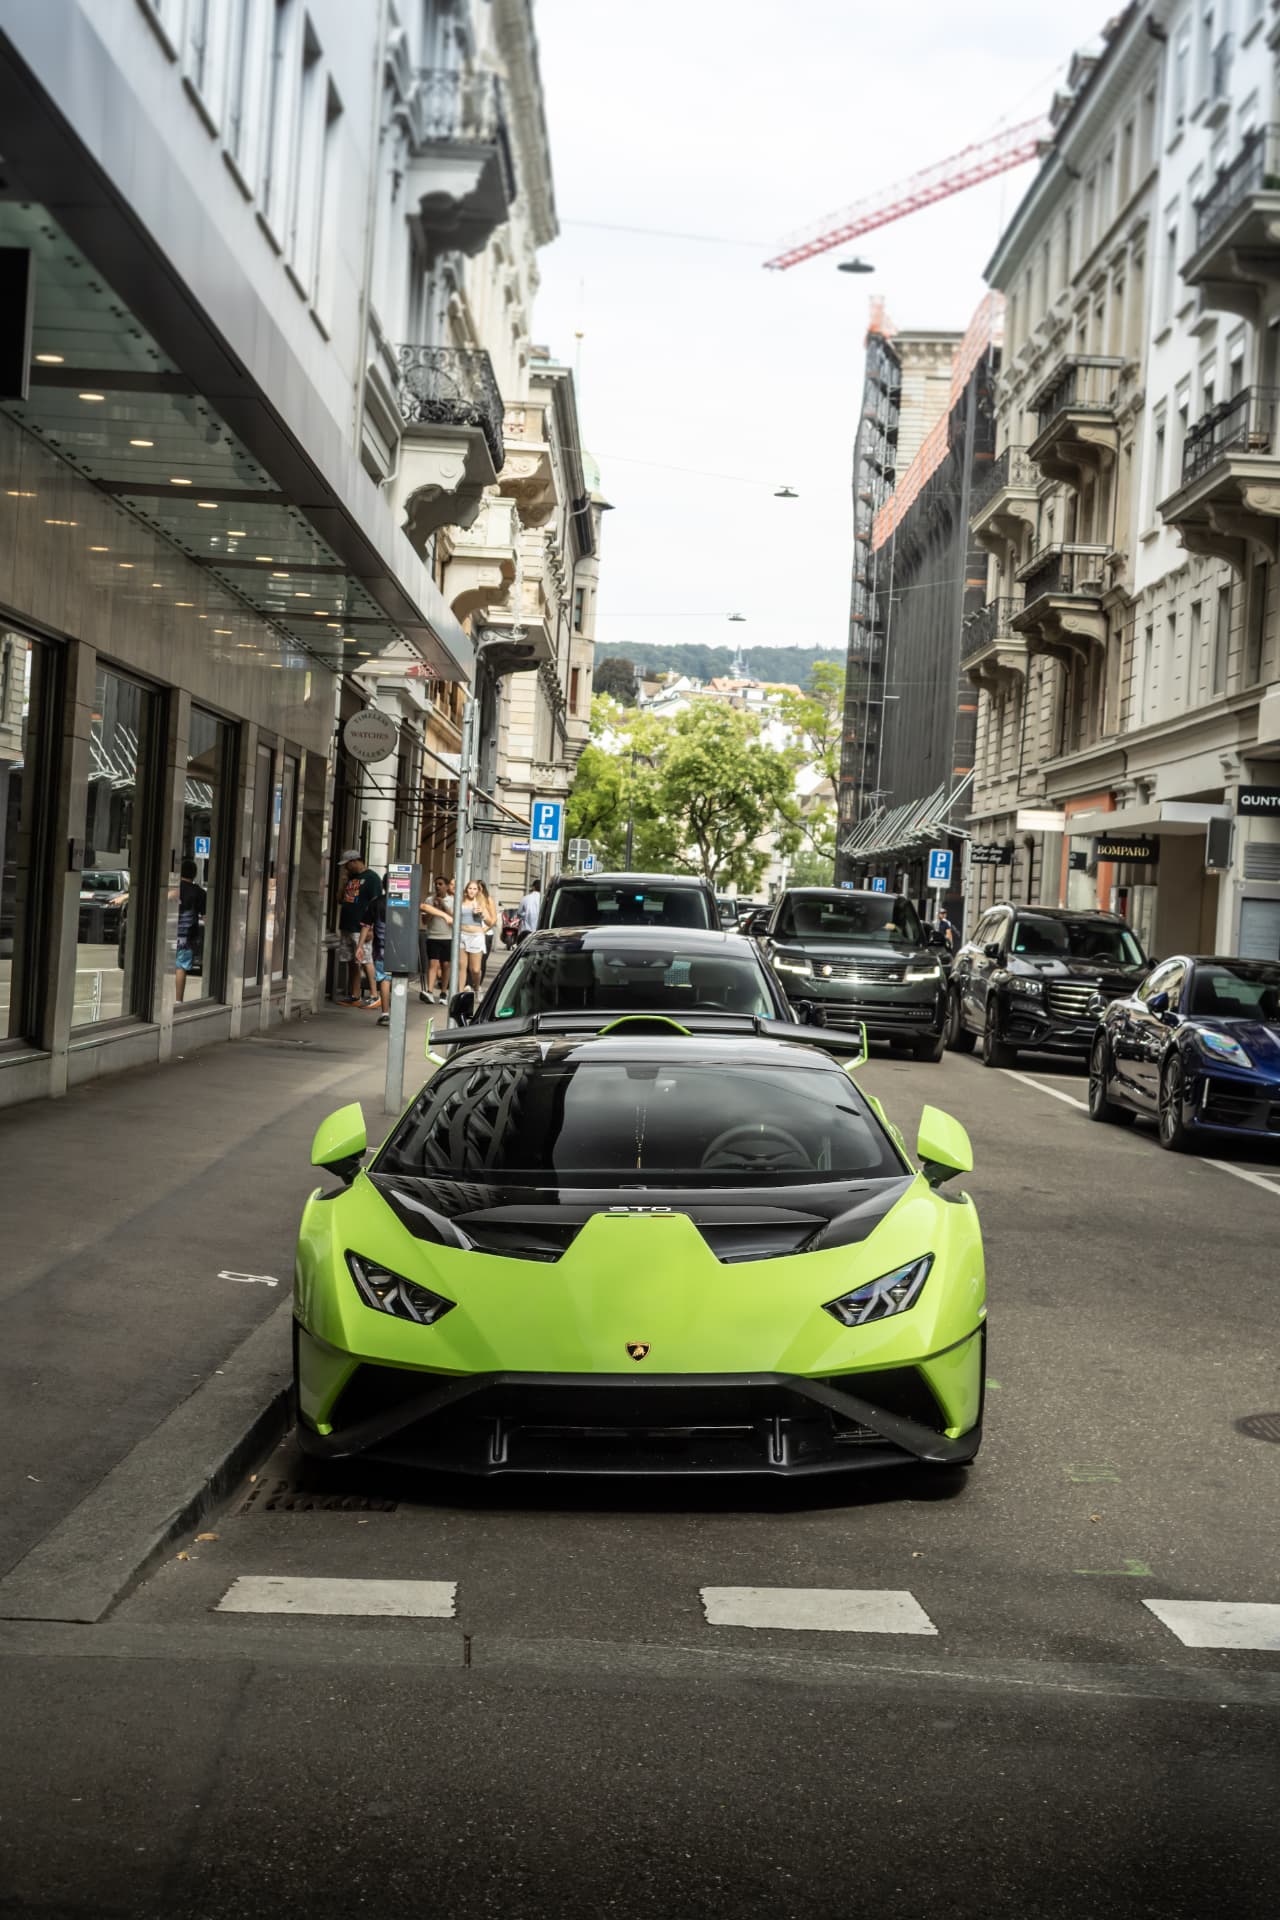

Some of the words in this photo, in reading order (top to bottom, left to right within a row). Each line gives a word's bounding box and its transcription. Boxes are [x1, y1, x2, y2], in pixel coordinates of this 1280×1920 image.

[350, 731, 389, 740] WATCHES
[352, 745, 386, 758] GALLERY
[1241, 795, 1280, 806] QUNT
[541, 805, 554, 824] P
[1097, 845, 1150, 857] BOMPARD
[936, 853, 947, 867] P
